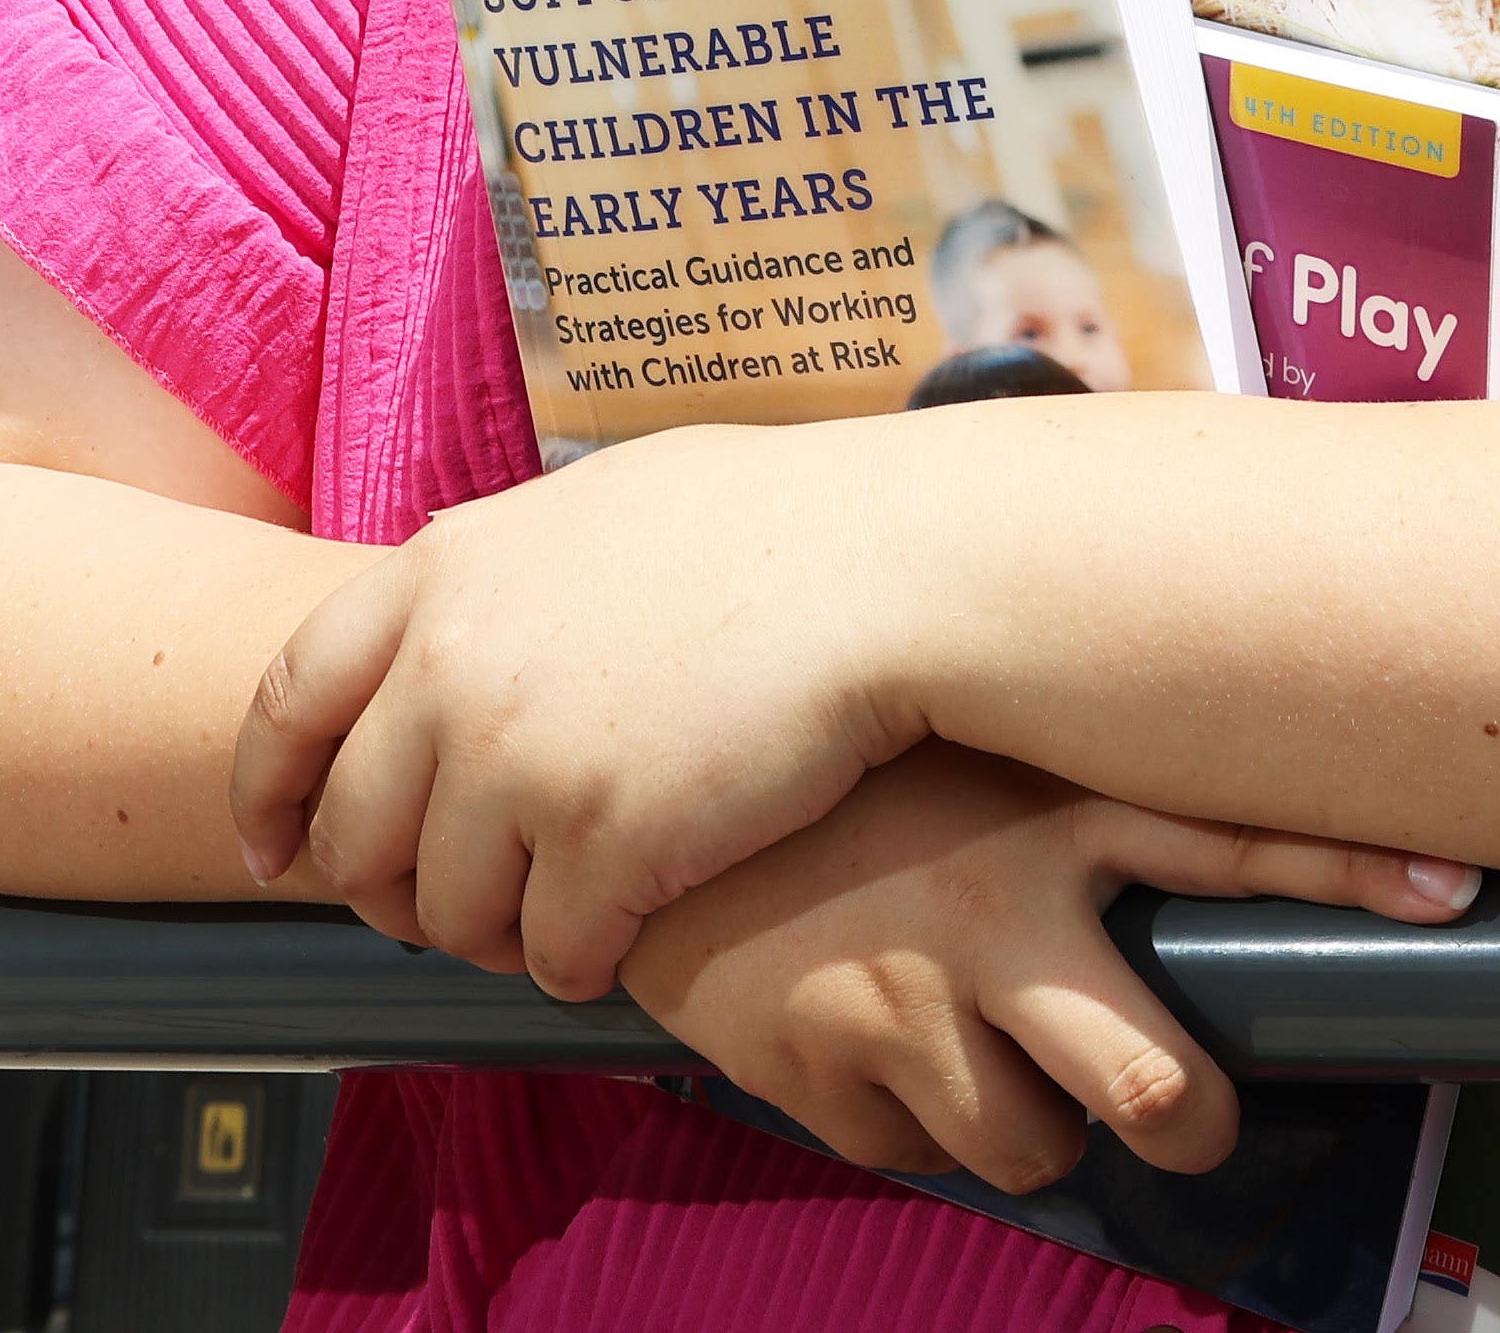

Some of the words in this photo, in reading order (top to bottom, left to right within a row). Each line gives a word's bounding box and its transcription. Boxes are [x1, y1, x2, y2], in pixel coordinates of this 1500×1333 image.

[493, 14, 842, 88] VULNERABLE
[513, 99, 781, 163] CHILDREN
[795, 90, 862, 141] IN
[874, 76, 995, 129] THE
[1244, 96, 1297, 127] 4TH
[1311, 112, 1445, 162] EDITION
[528, 186, 683, 238] EARLY
[696, 168, 873, 225] YEARS
[544, 259, 680, 297] Practical
[685, 249, 844, 286] Guidance
[851, 236, 916, 271] and
[555, 308, 711, 347] Strategies
[716, 302, 764, 333] for
[770, 289, 917, 328] Working
[1292, 253, 1458, 382] Play
[565, 360, 635, 392] with
[640, 352, 783, 388] Children
[790, 345, 825, 375] at
[829, 337, 902, 371] Risk
[1283, 356, 1316, 396] by
